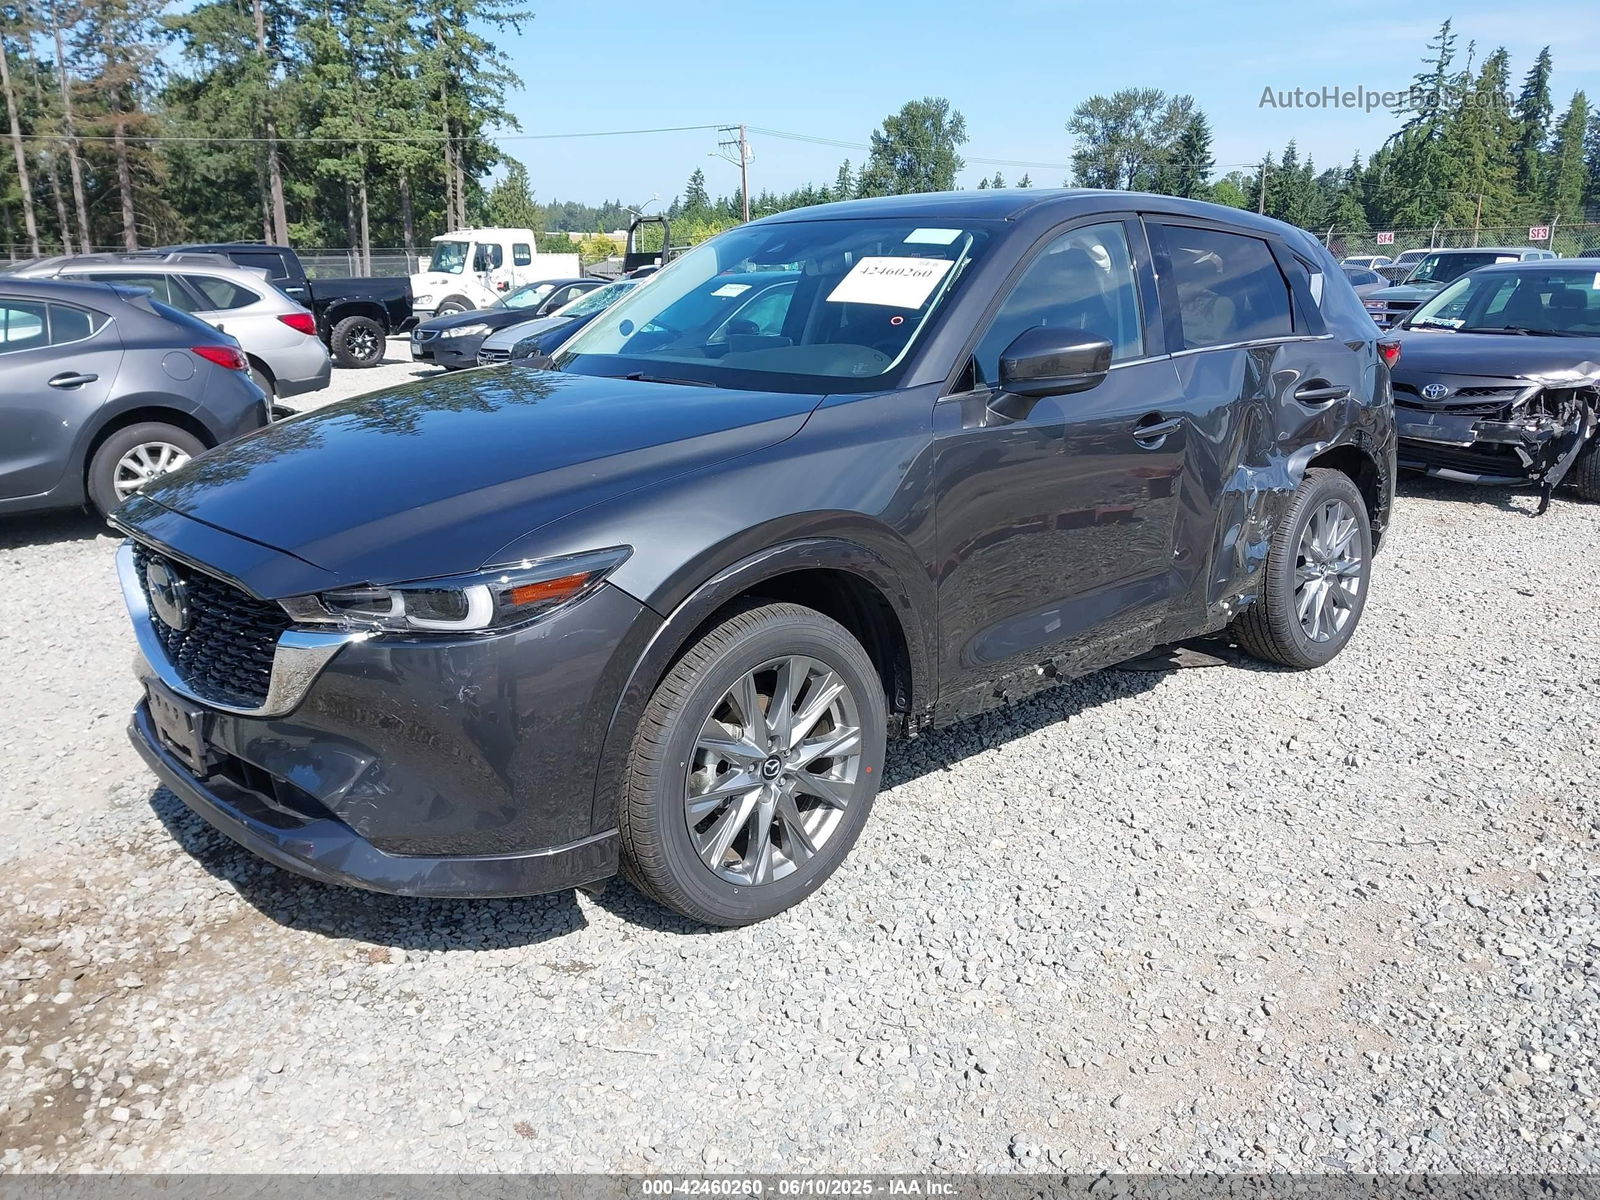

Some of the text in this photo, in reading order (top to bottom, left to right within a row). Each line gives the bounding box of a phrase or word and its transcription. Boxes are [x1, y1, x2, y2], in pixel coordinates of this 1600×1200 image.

[1378, 233, 1393, 244] SF4
[1530, 228, 1547, 239] SF3
[860, 266, 933, 278] 42460260
